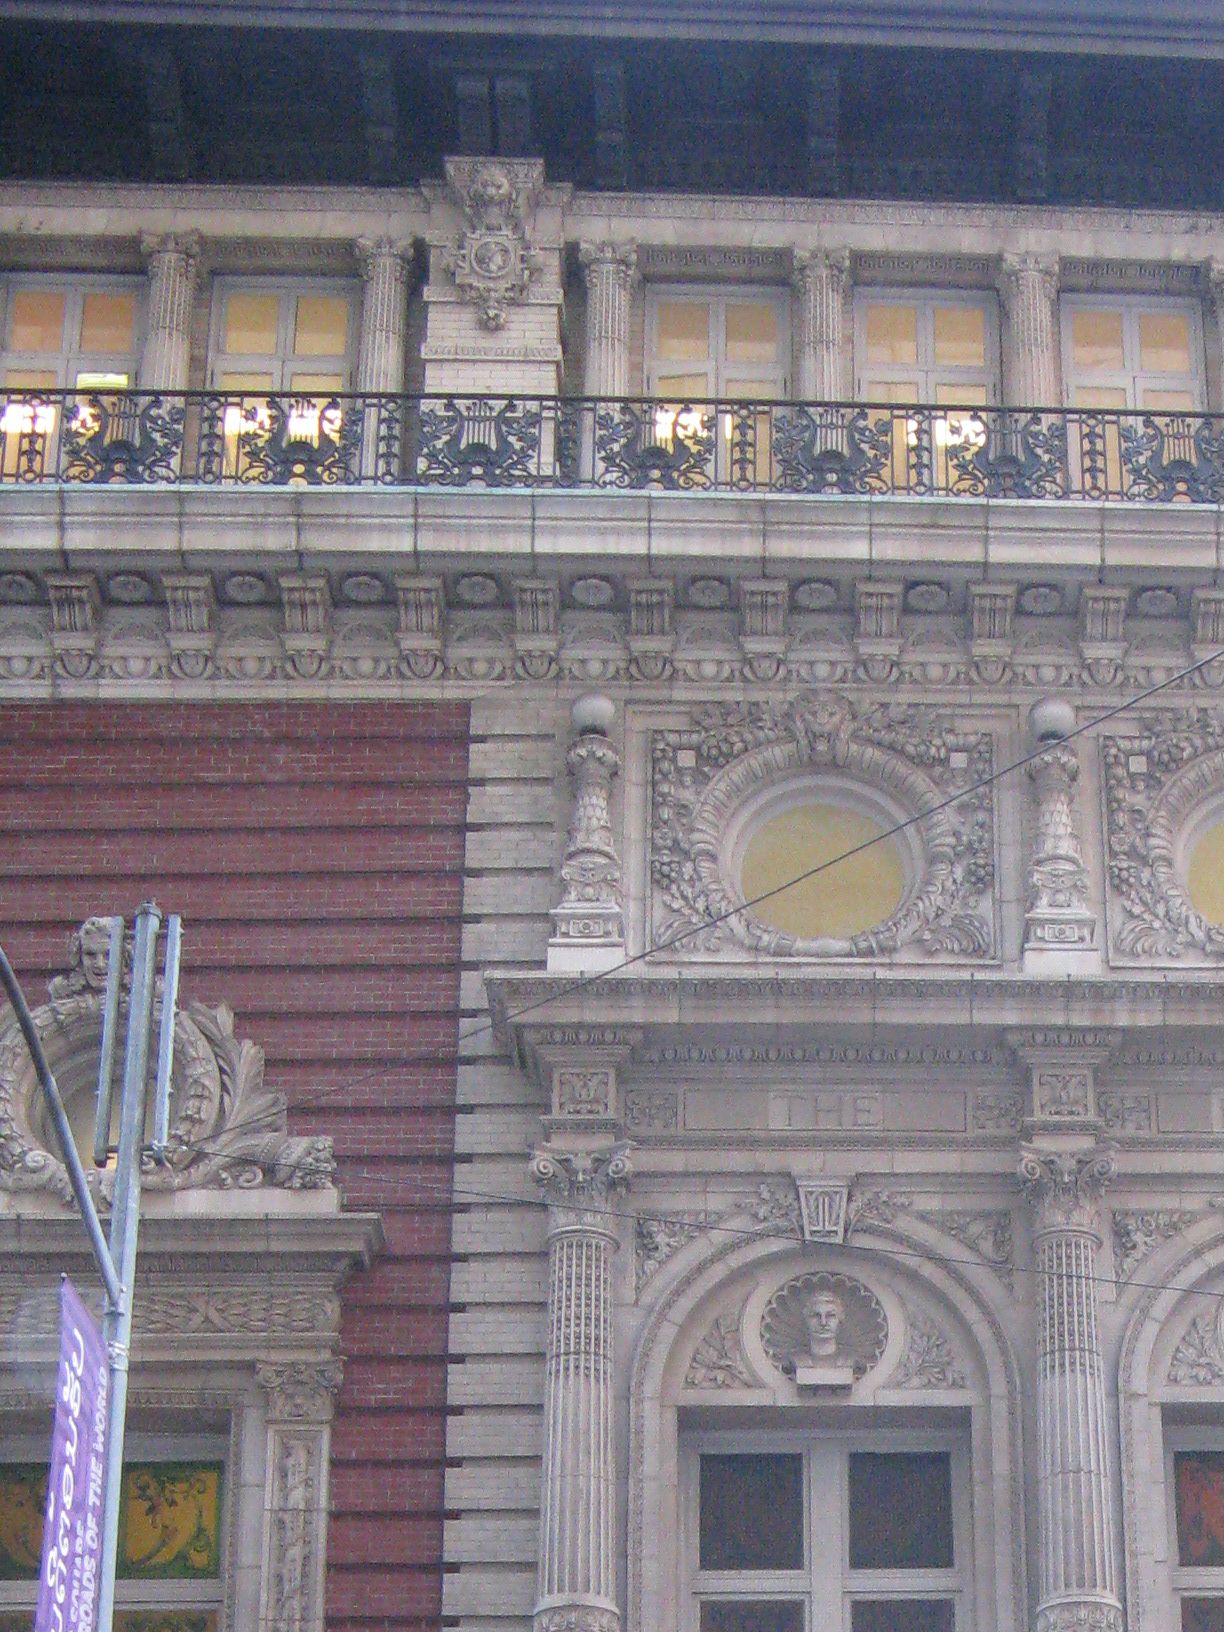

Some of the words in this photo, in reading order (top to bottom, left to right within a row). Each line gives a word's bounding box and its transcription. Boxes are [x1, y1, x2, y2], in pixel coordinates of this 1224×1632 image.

[773, 1096, 880, 1128] THE
[93, 1366, 109, 1453] WORLD
[89, 1455, 104, 1507] THE
[85, 1512, 99, 1550] OF
